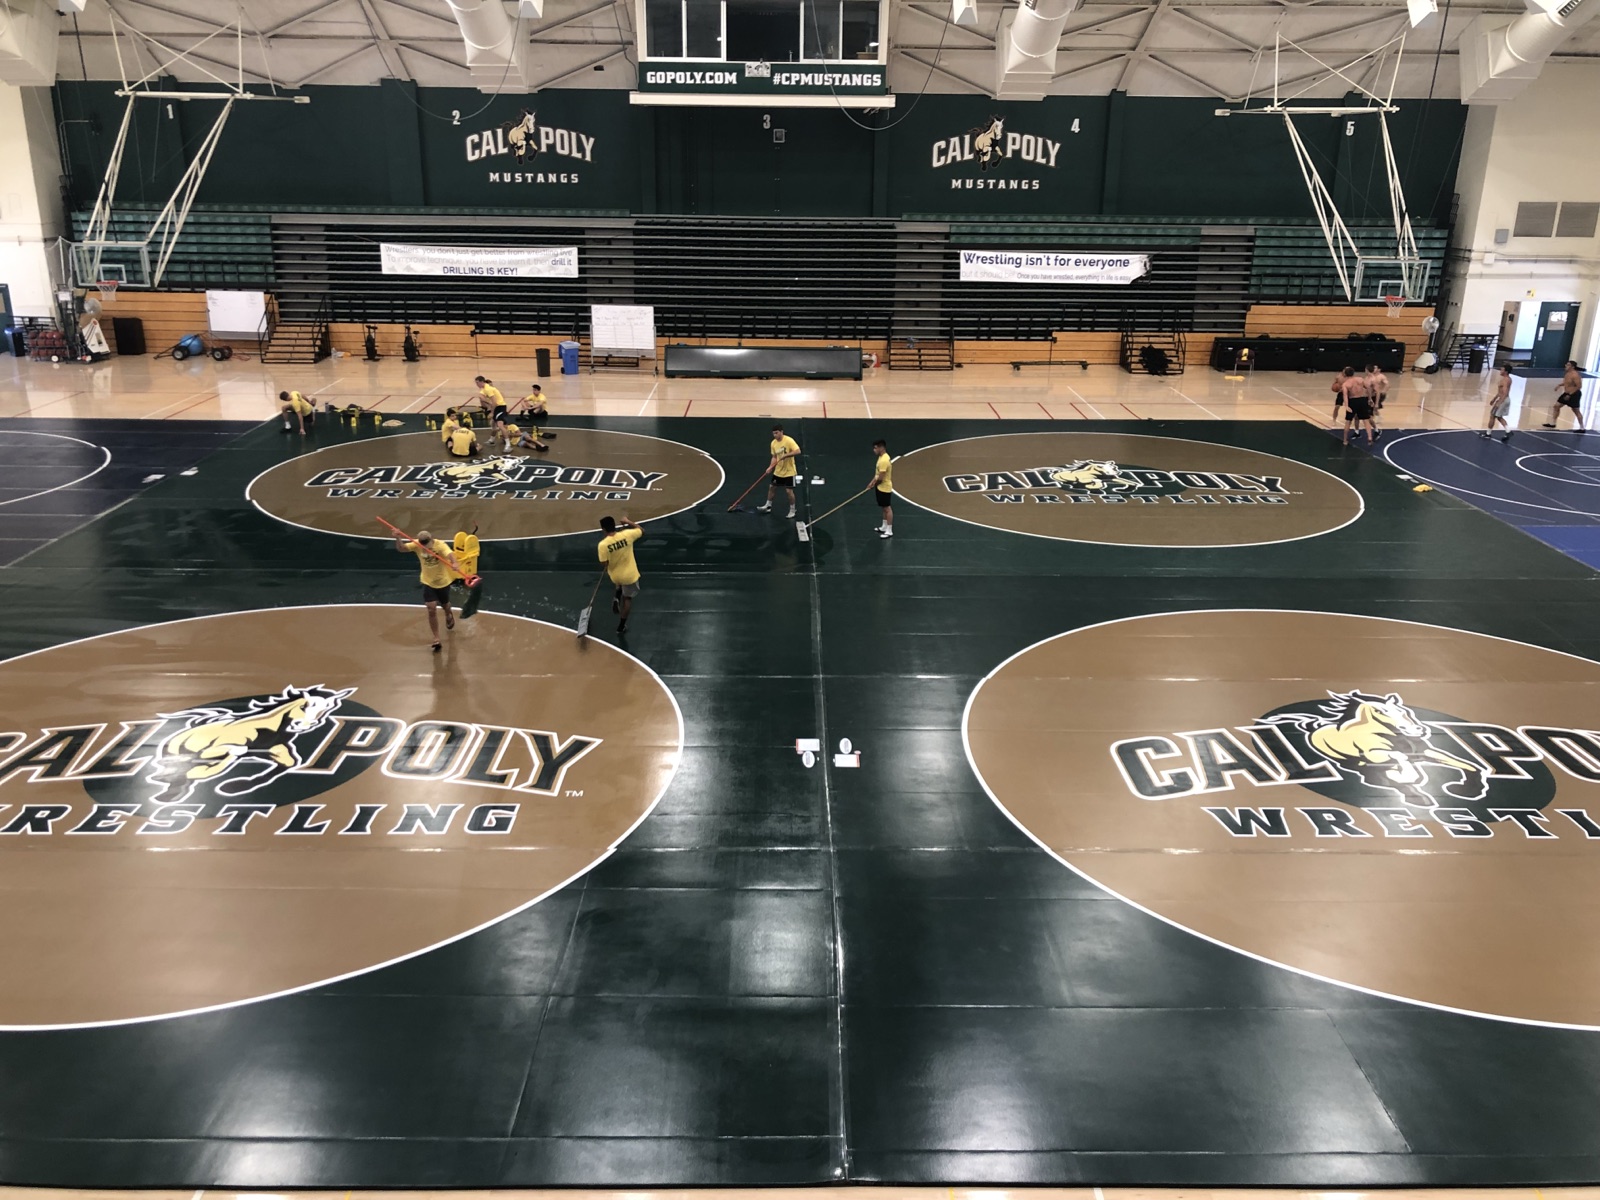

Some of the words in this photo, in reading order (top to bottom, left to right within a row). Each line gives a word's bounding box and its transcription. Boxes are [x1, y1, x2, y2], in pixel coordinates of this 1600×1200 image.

[646, 71, 738, 85] GOPOLY.COM
[772, 72, 882, 87] #CPMUSTANGS
[166, 104, 174, 119] 1
[452, 110, 461, 125] 2
[763, 114, 771, 129] 3
[1071, 118, 1081, 133] 4
[1346, 121, 1355, 136] 5
[466, 128, 508, 162] CAL
[539, 127, 596, 162] POLY
[932, 134, 975, 168] CAL
[1006, 132, 1061, 167] POLY
[489, 172, 579, 184] MUSTANGS
[951, 178, 1040, 190] MUSTANGS
[551, 258, 566, 266] drill
[566, 258, 572, 266] it
[963, 252, 1022, 268] Wrestling
[1025, 254, 1051, 267] isn't
[1054, 255, 1072, 267] for
[1074, 258, 1130, 270] everyone
[442, 266, 484, 275] DRILLING
[486, 267, 495, 275] IS
[497, 267, 518, 276] KEY!
[1017, 272, 1030, 280] Once
[1030, 273, 1040, 281] you
[304, 464, 434, 487] CAL
[512, 465, 668, 490] POLY
[943, 470, 1061, 493] CAL
[1124, 470, 1290, 494] POLY
[327, 488, 631, 501] WRESTLING
[982, 494, 1288, 504] WRESTLING
[607, 538, 629, 554] STAFF
[296, 715, 603, 798] POLY
[1110, 723, 1343, 801] CAL
[1431, 720, 1600, 784] PO
[0, 803, 520, 836] RESTLING
